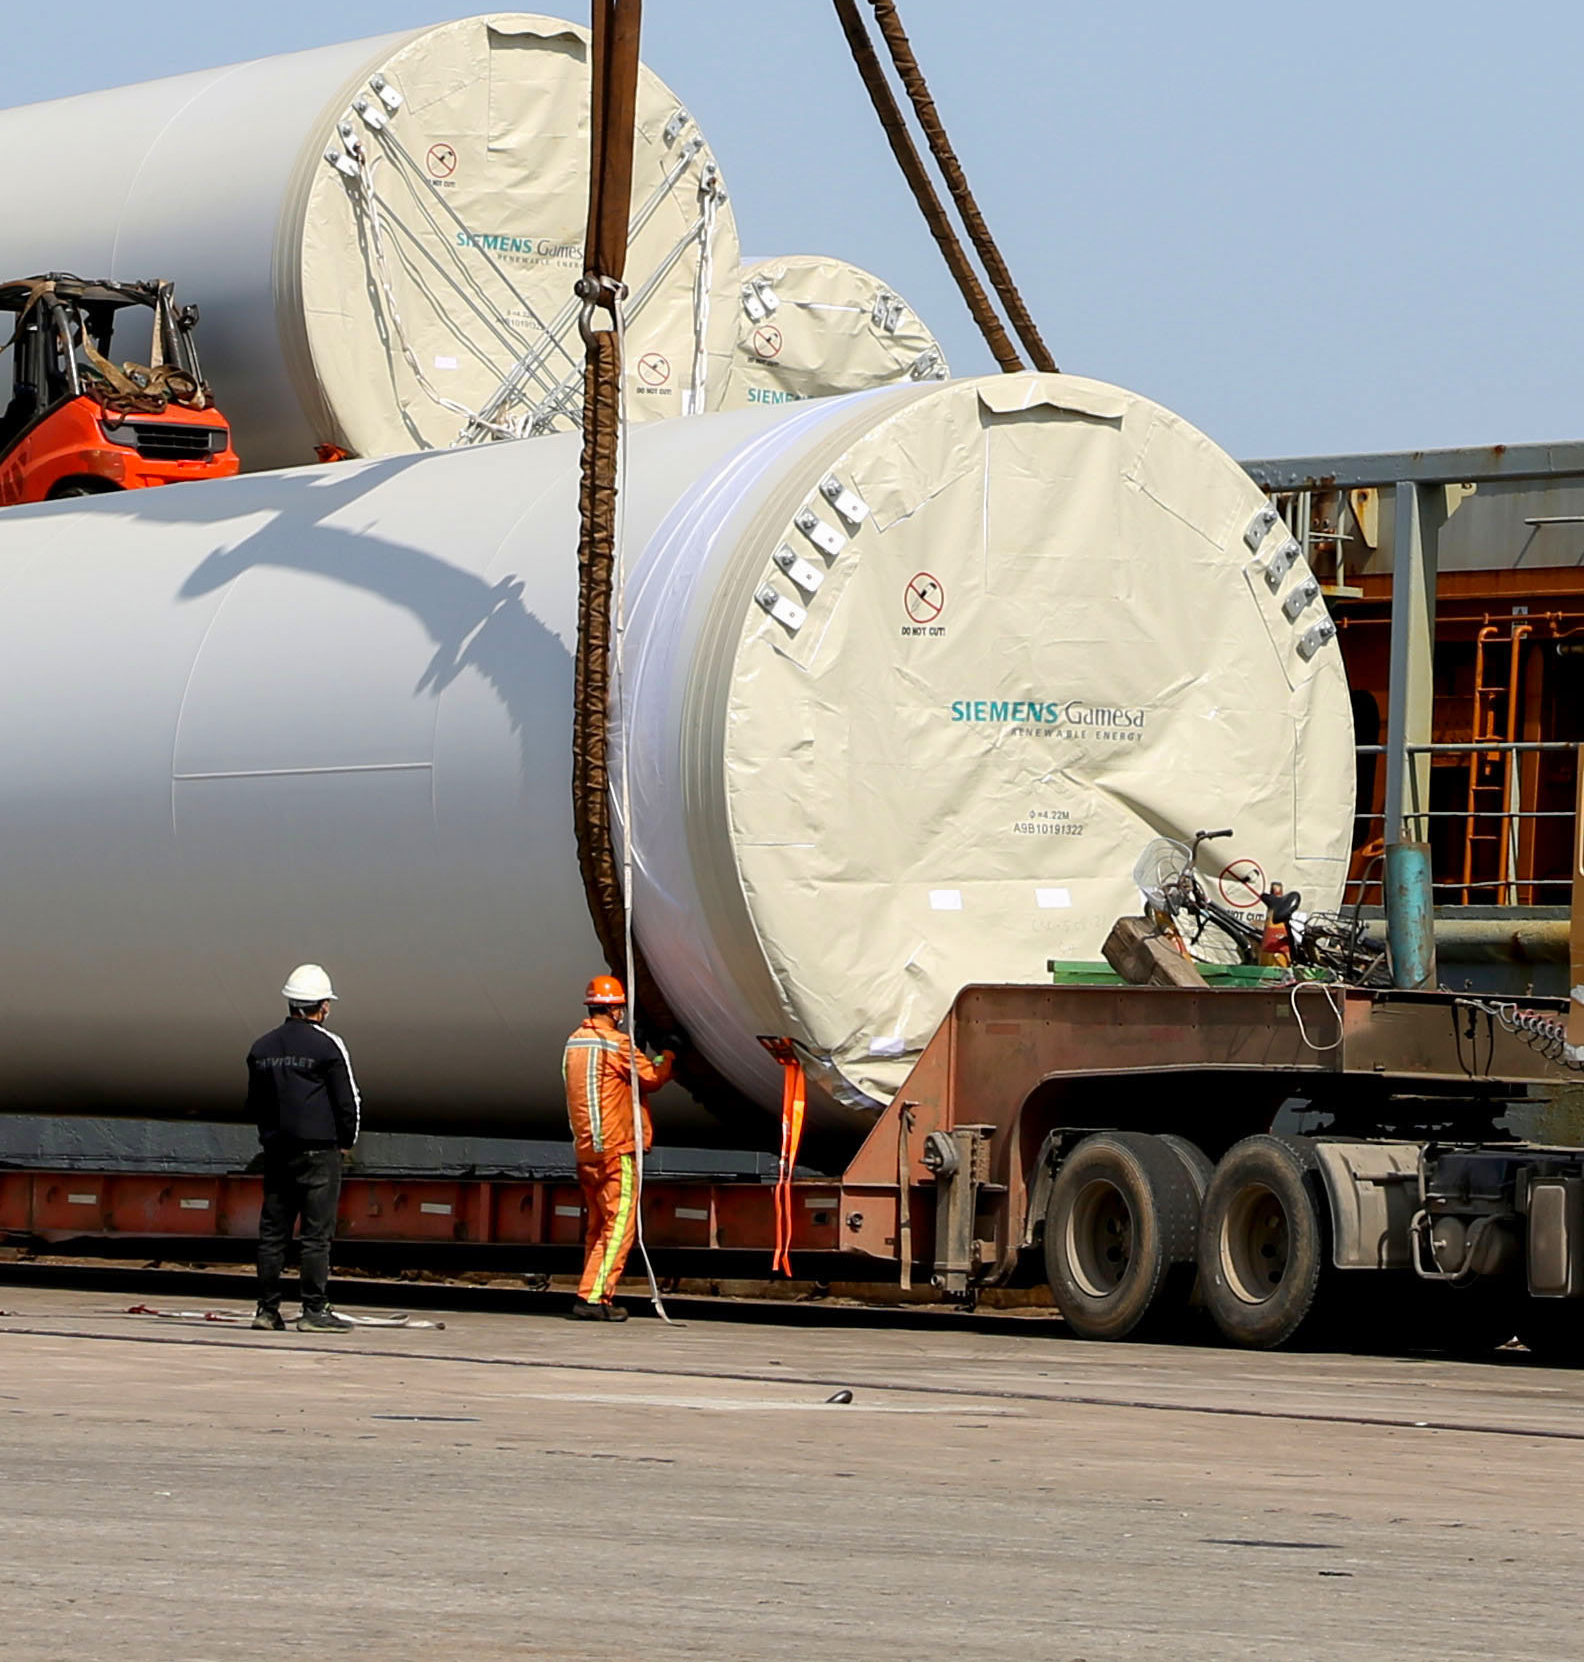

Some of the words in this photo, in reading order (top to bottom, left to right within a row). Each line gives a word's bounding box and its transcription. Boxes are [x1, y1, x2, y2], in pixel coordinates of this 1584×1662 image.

[537, 240, 584, 260] Games
[901, 626, 911, 636] DO
[912, 626, 926, 636] NOT
[951, 701, 1059, 723] SIEMENS
[1065, 700, 1144, 728] Gamesa
[1011, 727, 1086, 739] RENEWABLE
[1095, 730, 1144, 741] ENERGY
[1014, 823, 1084, 835] A9B10191322
